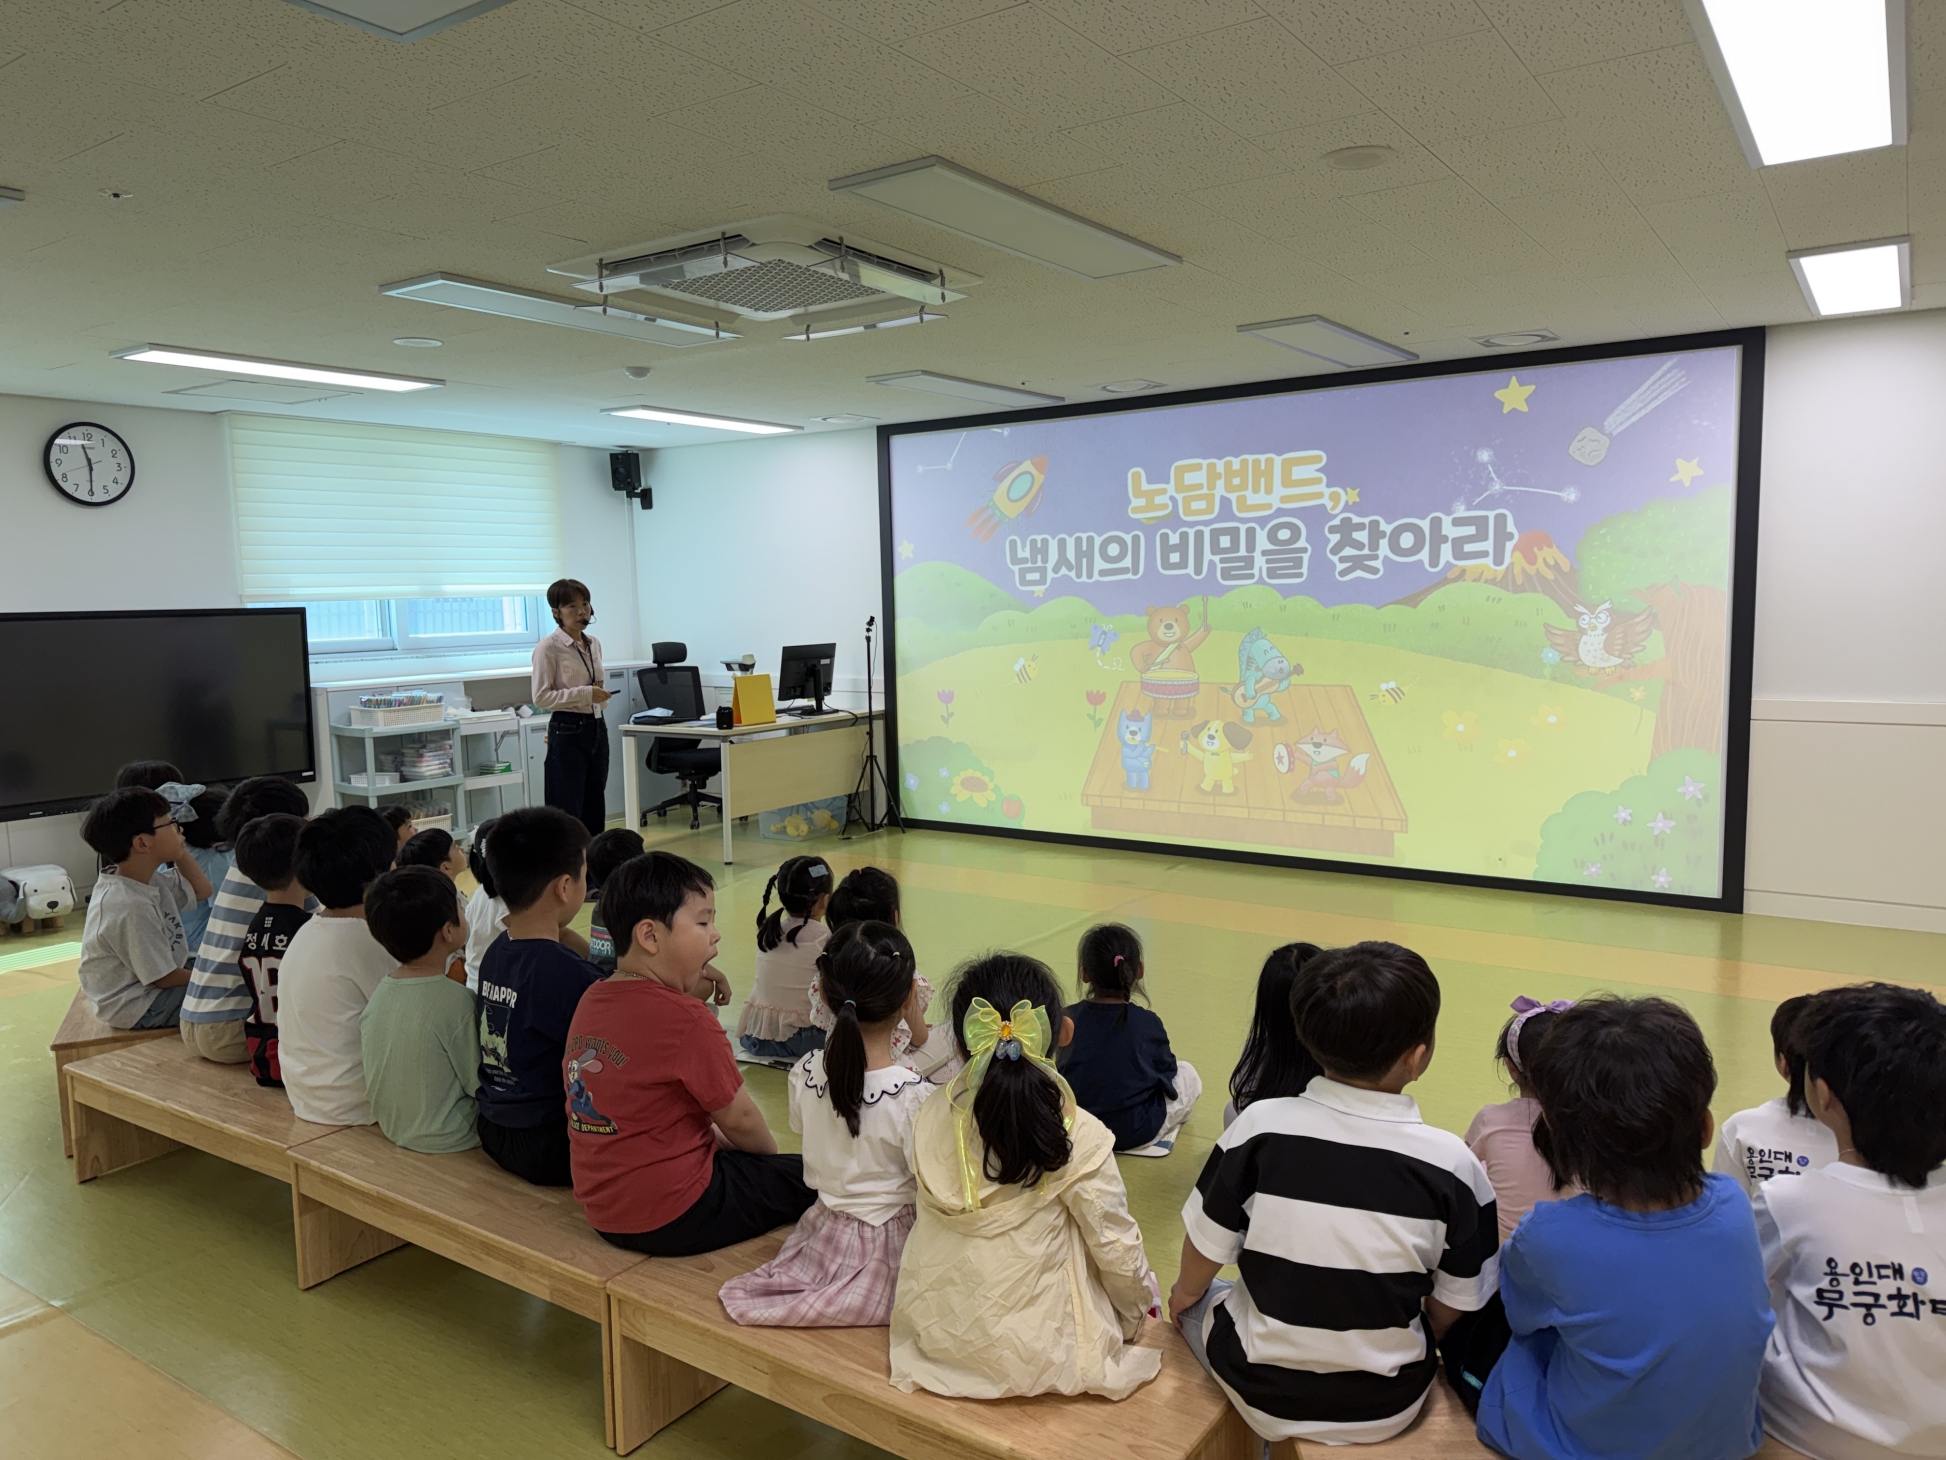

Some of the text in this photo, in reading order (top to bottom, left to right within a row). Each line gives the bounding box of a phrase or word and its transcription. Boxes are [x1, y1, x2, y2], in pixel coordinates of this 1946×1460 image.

[82, 432, 93, 442] 12
[58, 444, 69, 455] 10
[110, 449, 118, 459] 2
[55, 458, 63, 468] 9
[115, 462, 123, 472] 3
[61, 472, 69, 483] 8
[112, 476, 119, 486] 4
[73, 483, 80, 493] 7
[102, 485, 109, 494] 5
[1130, 452, 1343, 518] 노담밴드,
[1008, 511, 1515, 588] 냄새의 비밀을 찾아라
[1746, 1146, 1793, 1165] 용인대
[1823, 1256, 1905, 1288] 용인대
